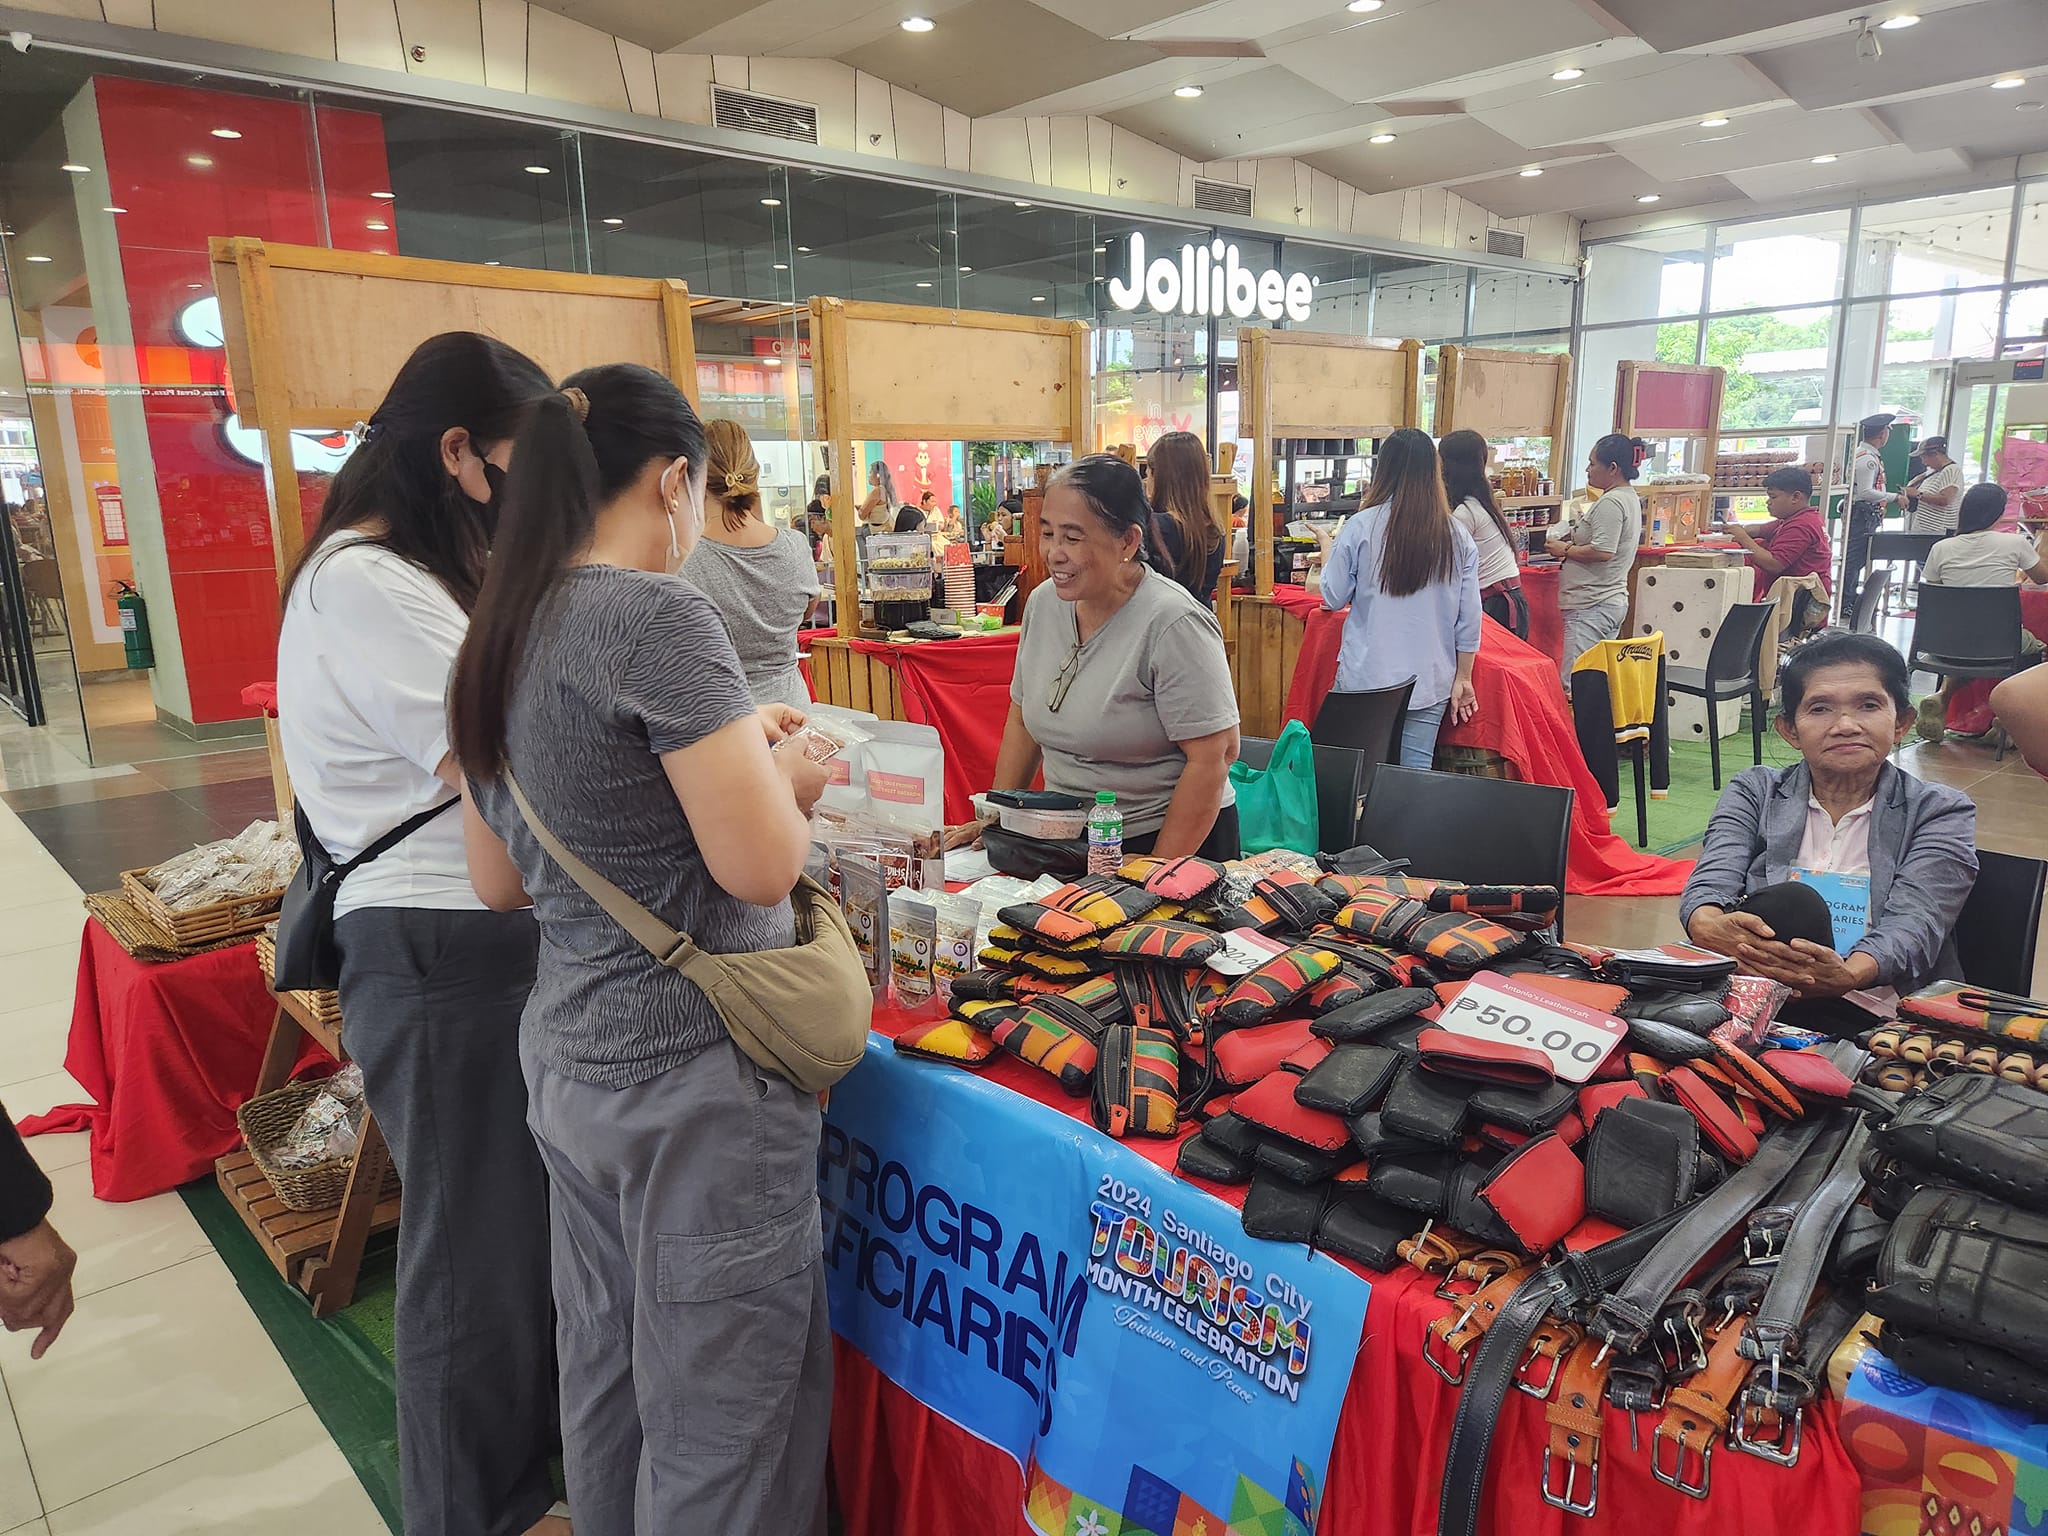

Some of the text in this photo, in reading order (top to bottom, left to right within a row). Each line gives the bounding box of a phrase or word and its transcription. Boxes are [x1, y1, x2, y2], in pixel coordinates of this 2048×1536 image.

[1109, 231, 1313, 322] Jollibee
[1826, 901, 1866, 913] OGRAM
[1833, 915, 1864, 925] ARIES
[1450, 997, 1602, 1063] ₱50.00
[1503, 983, 1590, 1019] Antonio's Leathercraft
[819, 1121, 1088, 1358] PROGRAM
[1098, 1174, 1313, 1320] 2024 Santiago City
[820, 1197, 1057, 1437] EFICIARIES
[1086, 1258, 1299, 1402] MONTH CELEBRATION
[1090, 1200, 1311, 1374] TOURISM
[1180, 1347, 1209, 1367] and
